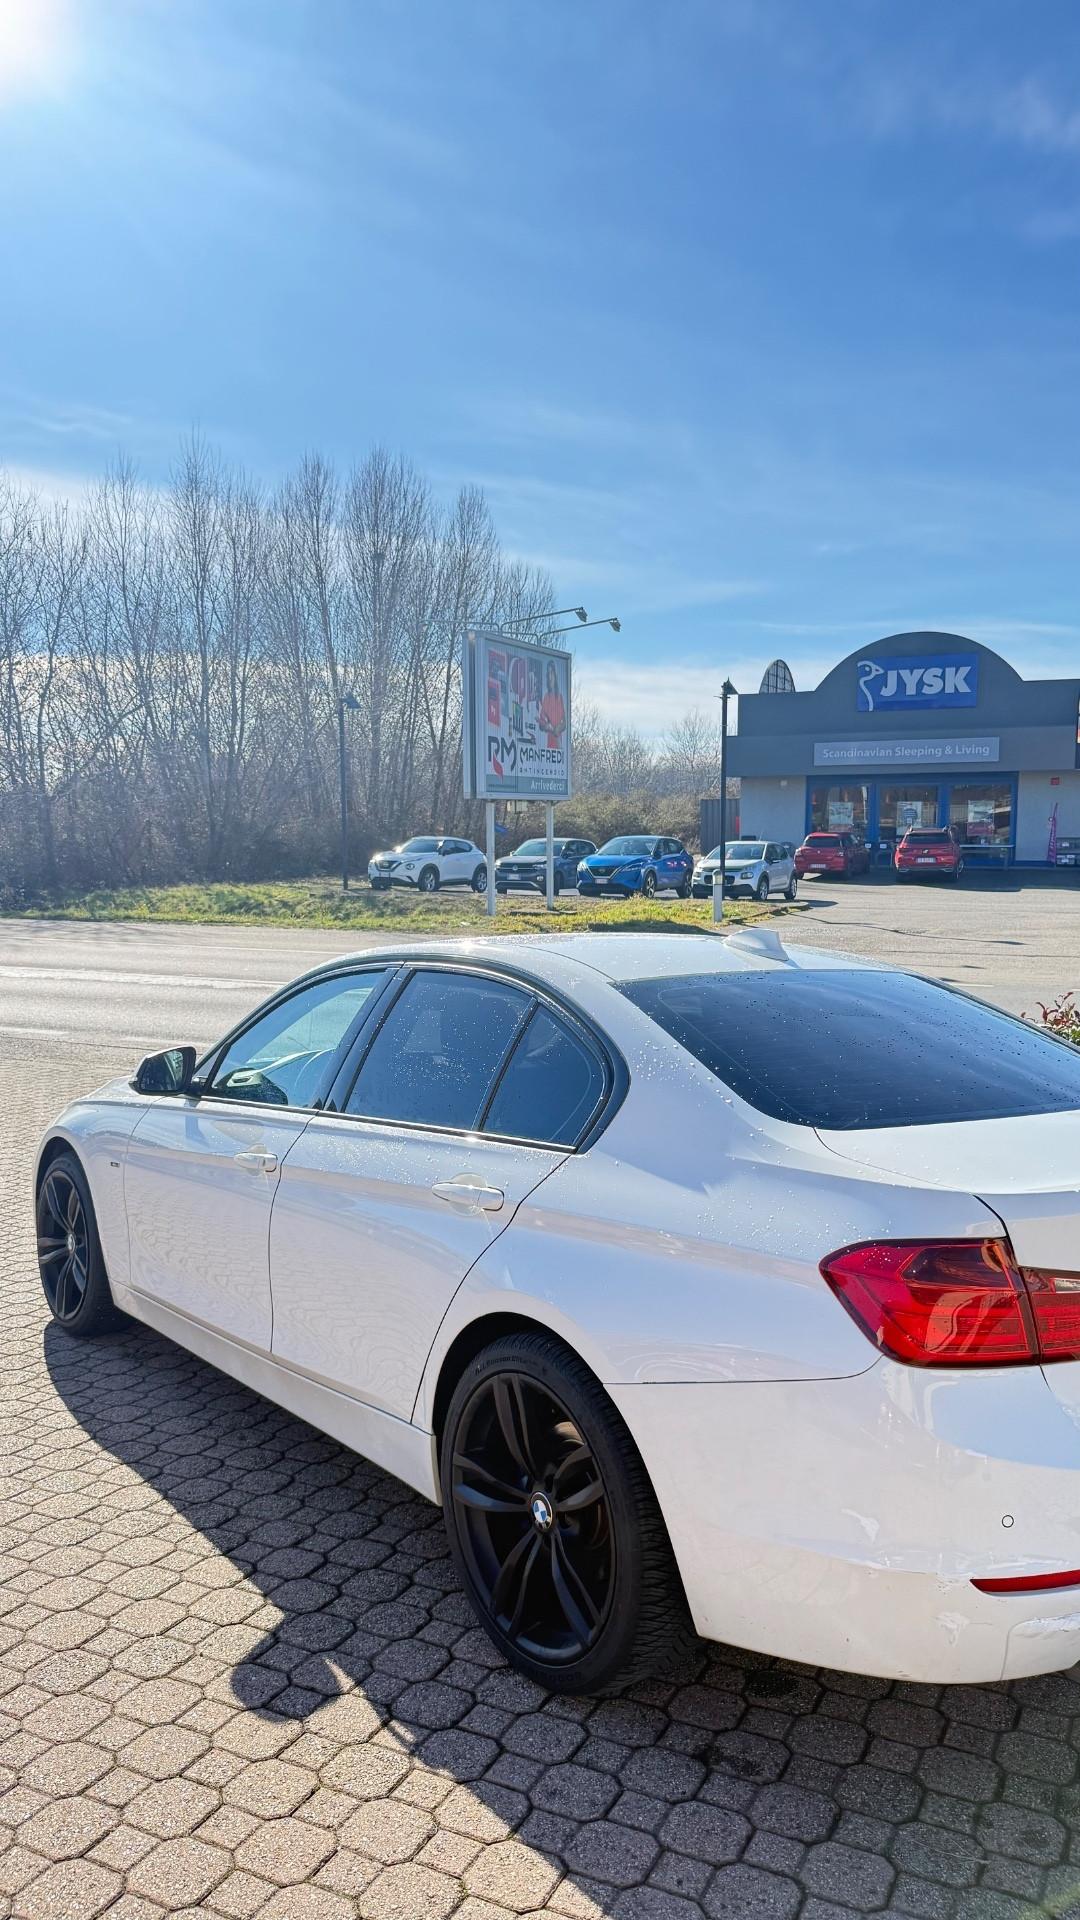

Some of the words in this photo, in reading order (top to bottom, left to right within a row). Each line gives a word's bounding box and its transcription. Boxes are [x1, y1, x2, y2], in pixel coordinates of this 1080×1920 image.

[880, 666, 972, 697] JYSK
[519, 746, 565, 765] MANFREDI
[823, 747, 892, 758] Scandinavian
[895, 746, 942, 758] Sleeping
[944, 744, 953, 755] &
[955, 743, 990, 756] Living
